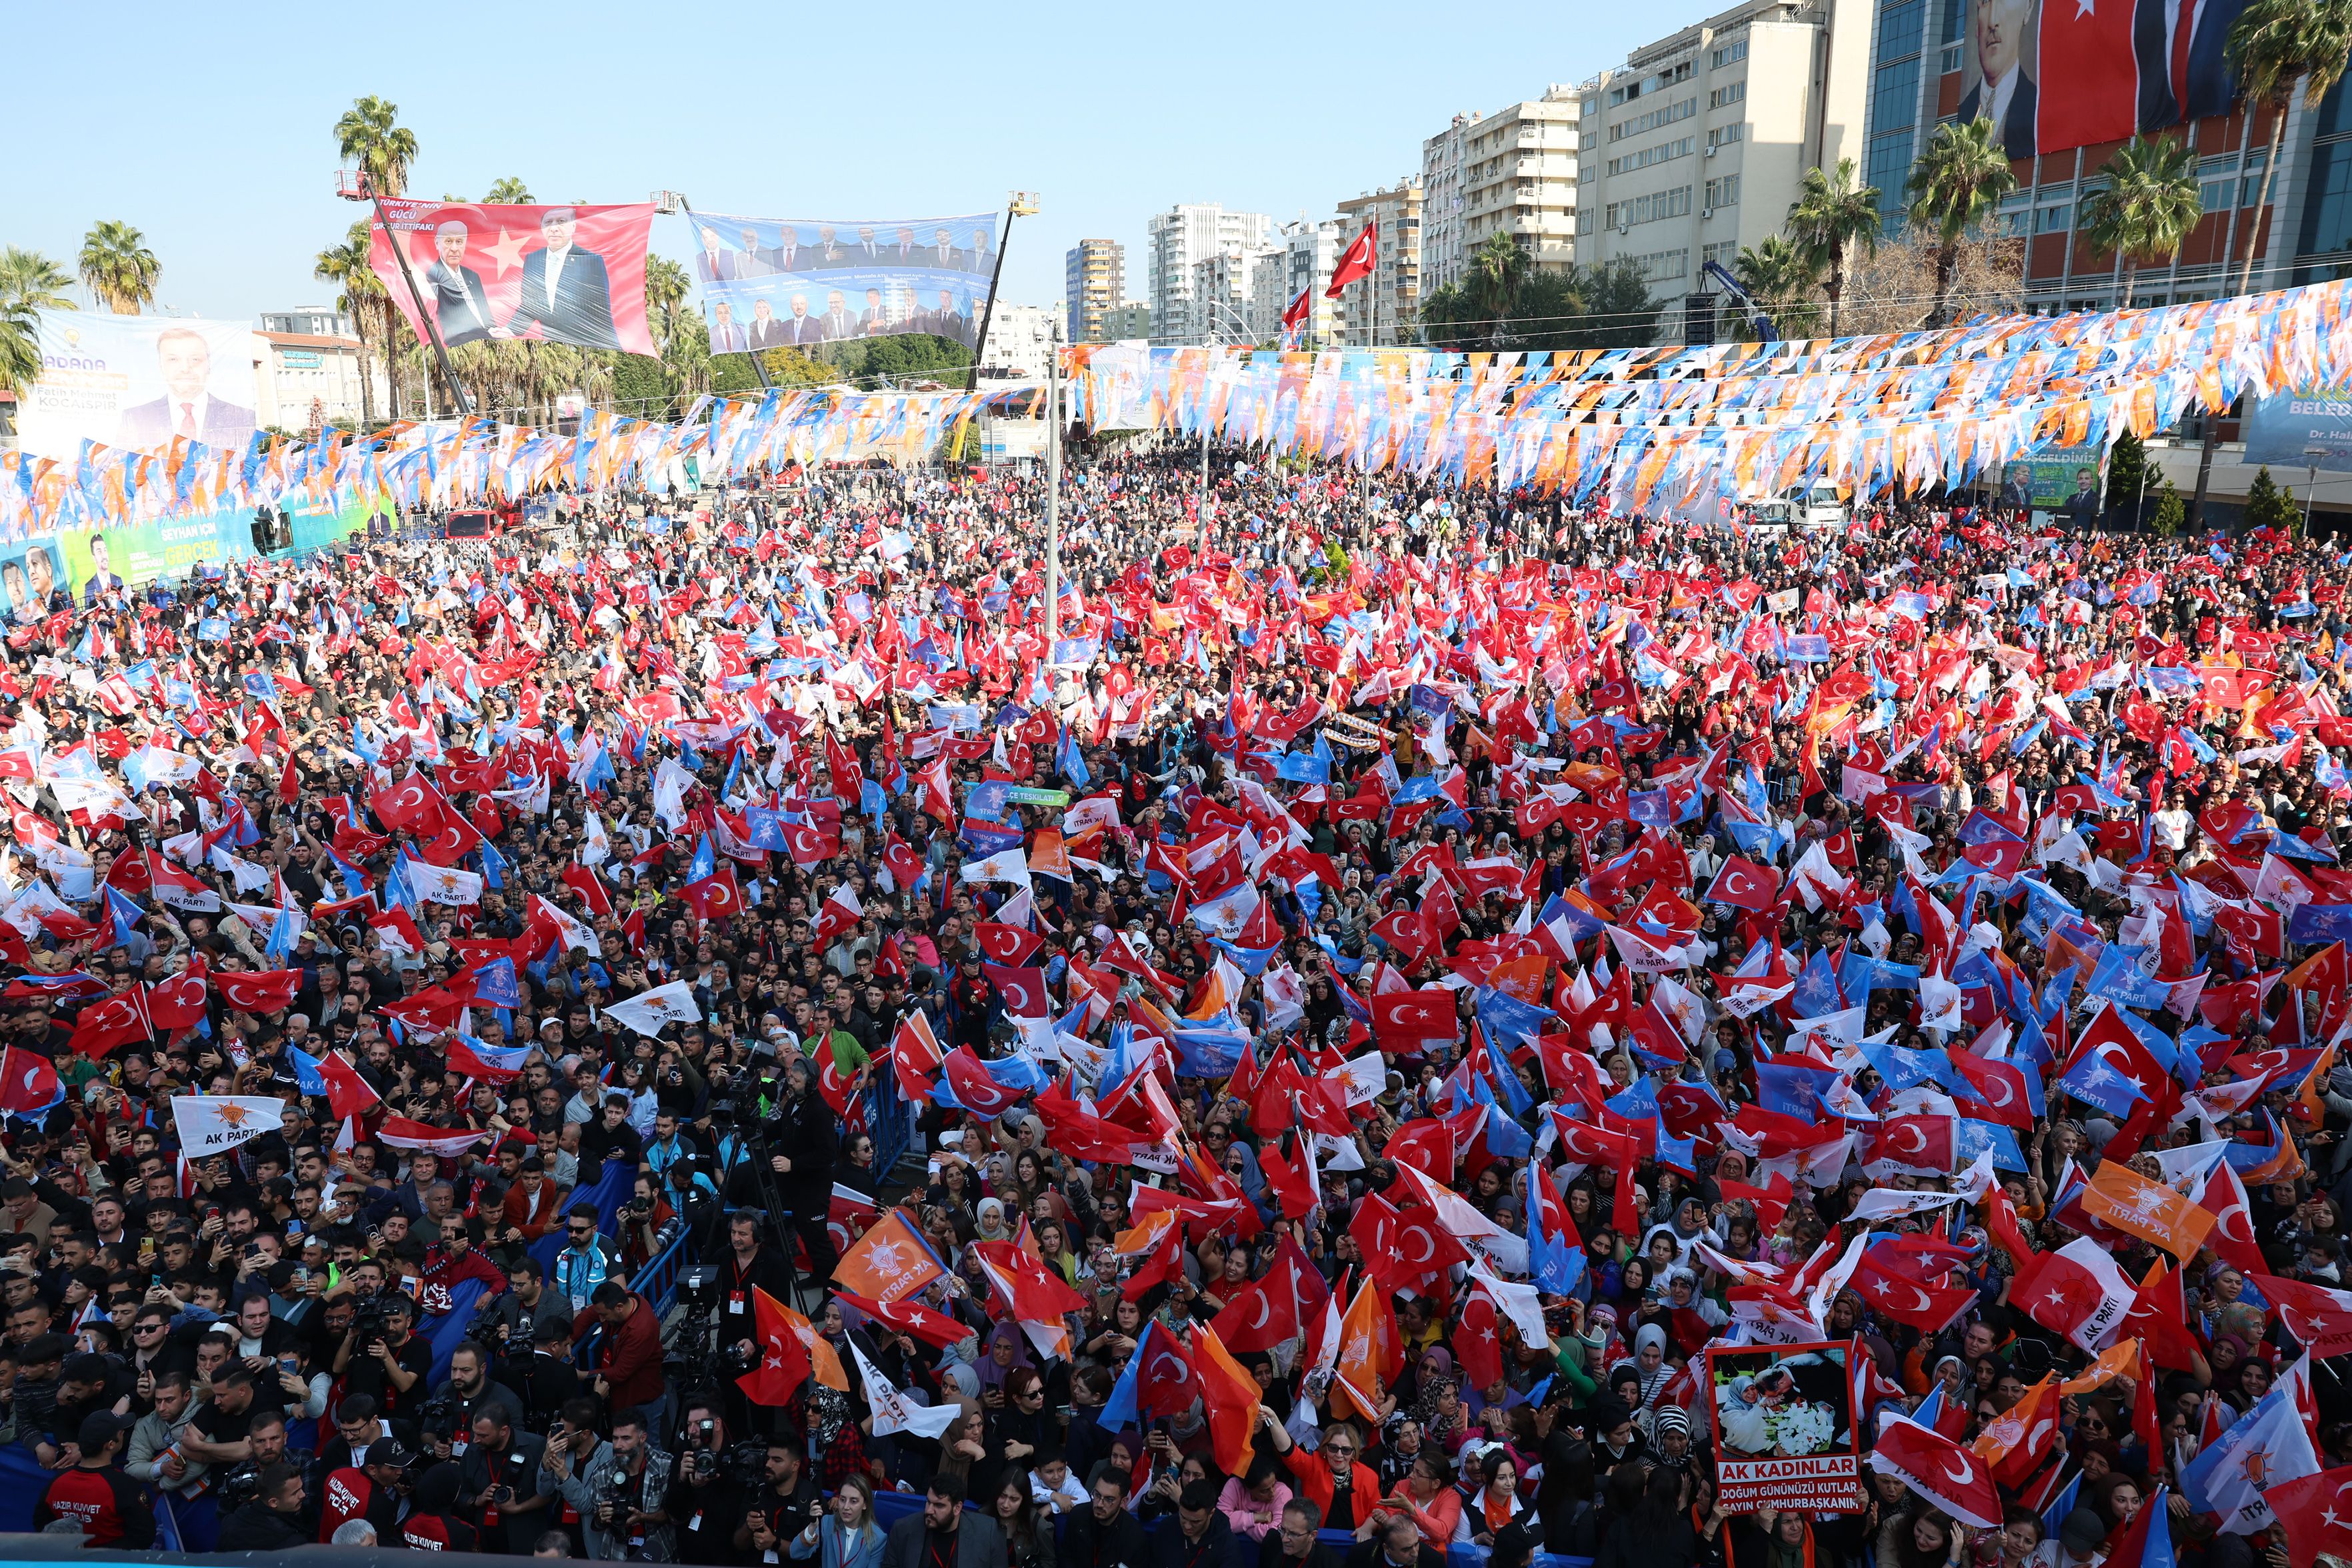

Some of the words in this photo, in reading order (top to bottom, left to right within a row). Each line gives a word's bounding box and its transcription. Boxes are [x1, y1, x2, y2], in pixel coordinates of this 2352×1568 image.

[389, 209, 417, 219] GÜCÜ
[44, 356, 106, 371] ADANA
[37, 387, 67, 396] Fatih
[71, 389, 117, 399] Mehmet
[2309, 430, 2326, 439] Dr.
[1663, 483, 1700, 500] Alts
[161, 526, 198, 541] SEYHAN
[1008, 792, 1018, 801] ÇE
[2102, 986, 2116, 994] AK
[1896, 1071, 1911, 1082] AK
[299, 1081, 313, 1089] AK
[2059, 1078, 2072, 1089] AK
[205, 1134, 223, 1144] AK
[2085, 1323, 2103, 1341] AK
[863, 1361, 881, 1378] AK
[1721, 1463, 1749, 1480] AK
[1755, 1458, 1853, 1478] KADINLAR
[329, 1478, 343, 1495] HAZIR
[1721, 1486, 1757, 1499] DOĞUM
[1760, 1481, 1815, 1495] GÜNÜNÜZÜ
[1818, 1482, 1857, 1493] KUTLAR
[53, 1501, 71, 1510] HAZIR
[73, 1503, 101, 1513] KUVVET
[419, 1536, 443, 1551] KUVVET
